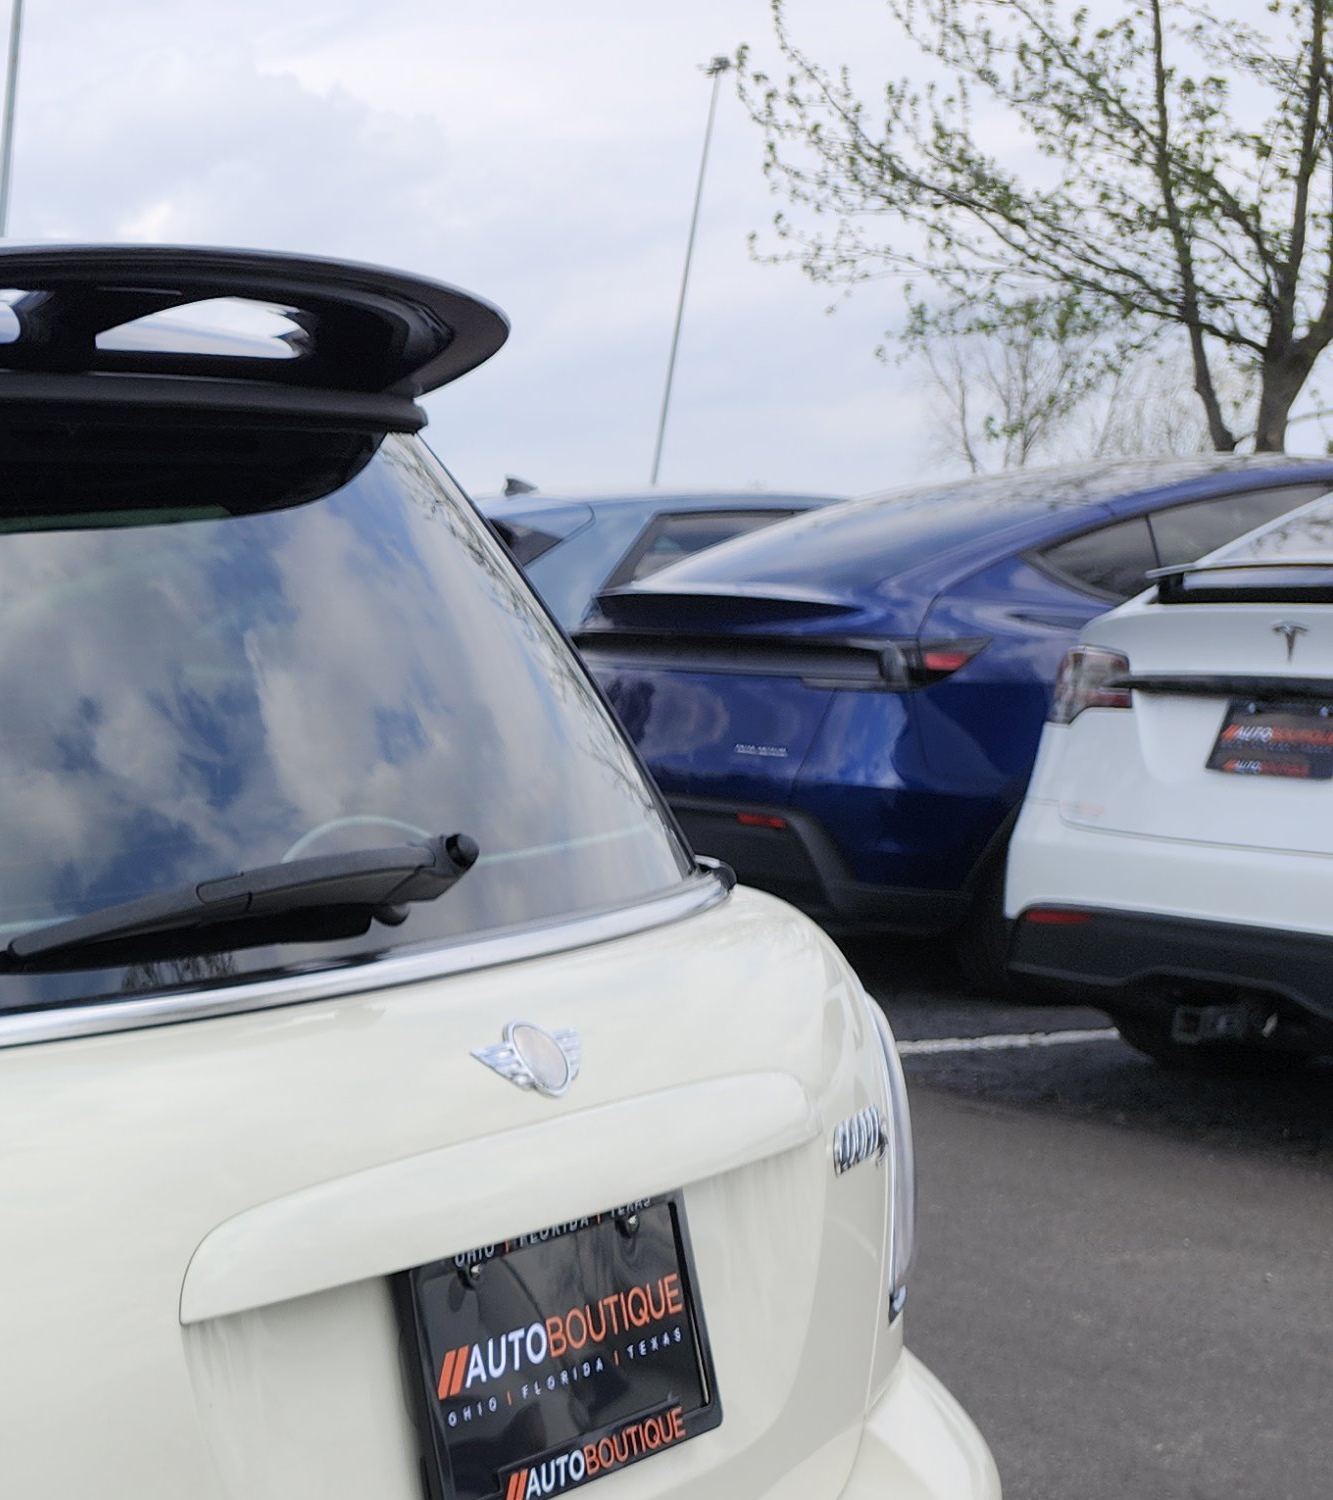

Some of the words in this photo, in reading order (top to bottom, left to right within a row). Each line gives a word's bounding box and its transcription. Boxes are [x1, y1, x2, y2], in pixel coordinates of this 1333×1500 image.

[448, 1397, 497, 1428] OHIO
[521, 1357, 605, 1400] FLORIDA
[626, 1326, 682, 1360] TEXAS
